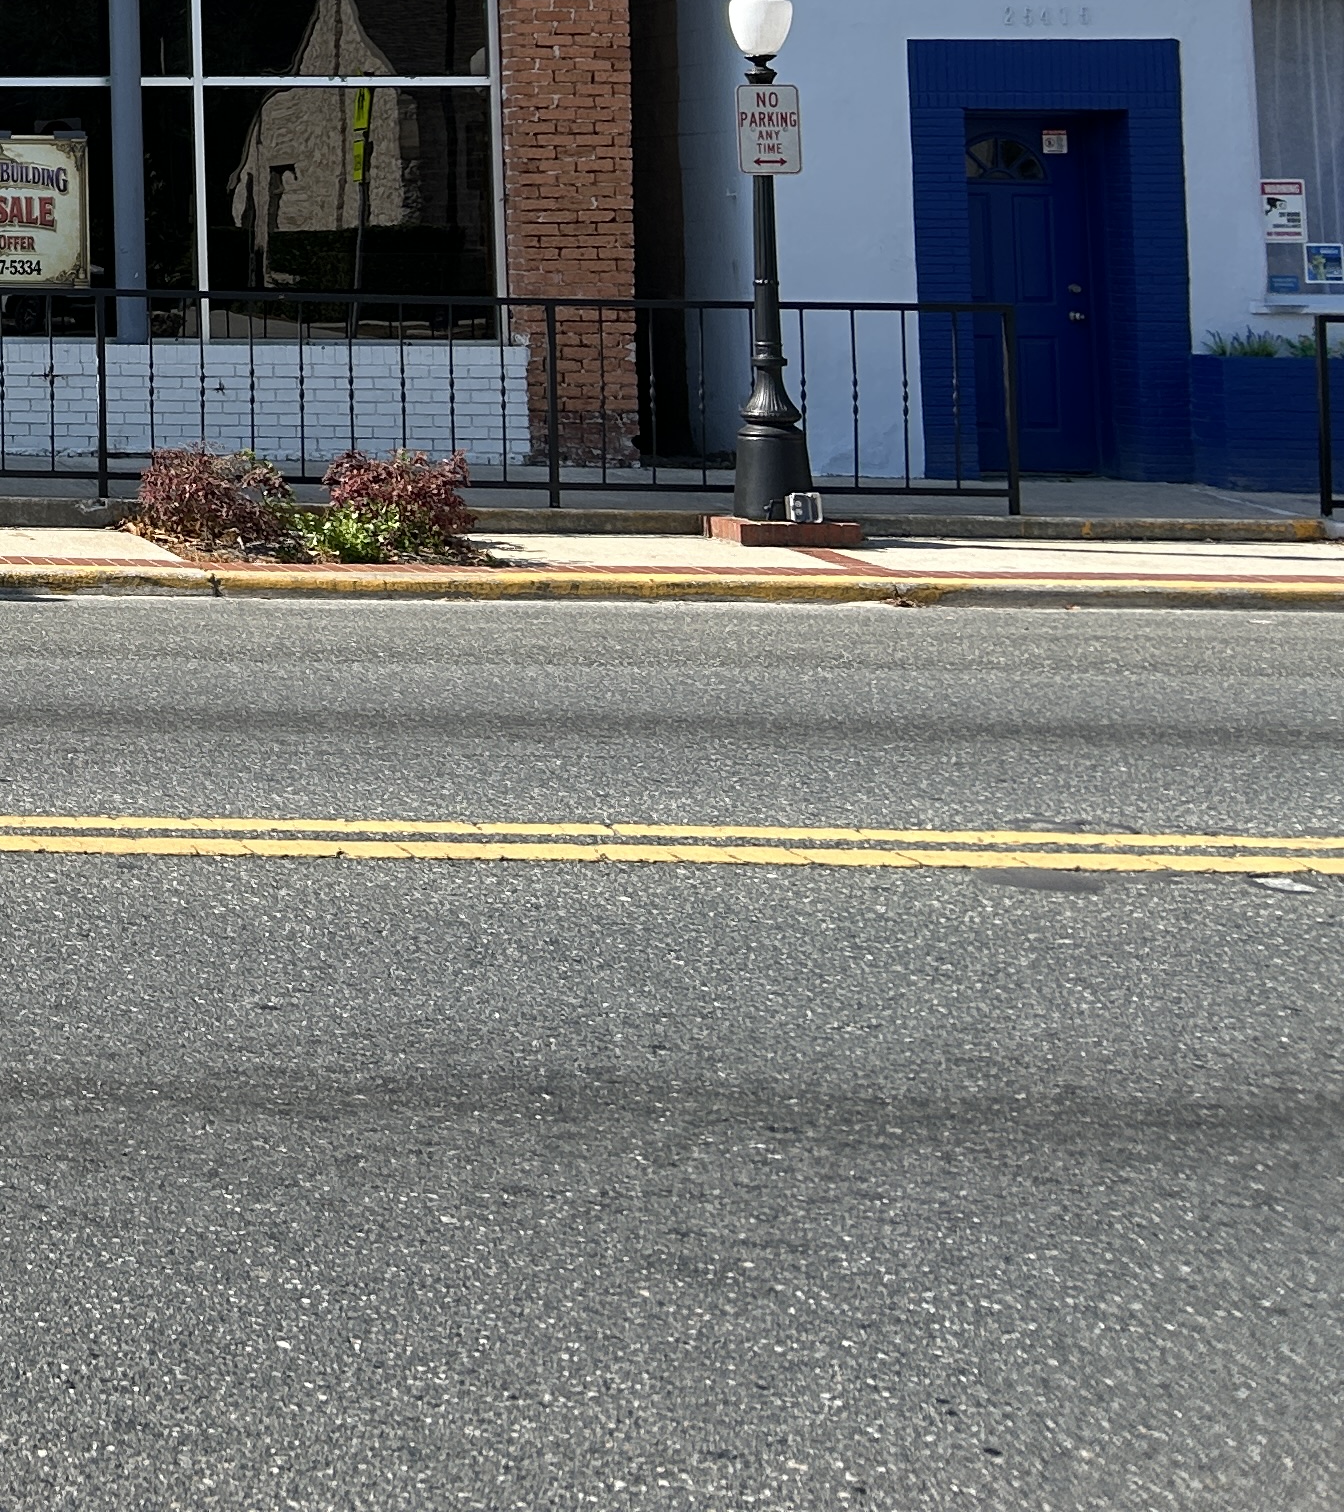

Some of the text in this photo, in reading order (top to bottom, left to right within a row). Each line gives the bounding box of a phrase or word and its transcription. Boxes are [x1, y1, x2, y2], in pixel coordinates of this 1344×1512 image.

[756, 91, 779, 108] NO
[739, 111, 797, 128] PARKING
[757, 130, 781, 141] ANY
[756, 142, 783, 154] TIME
